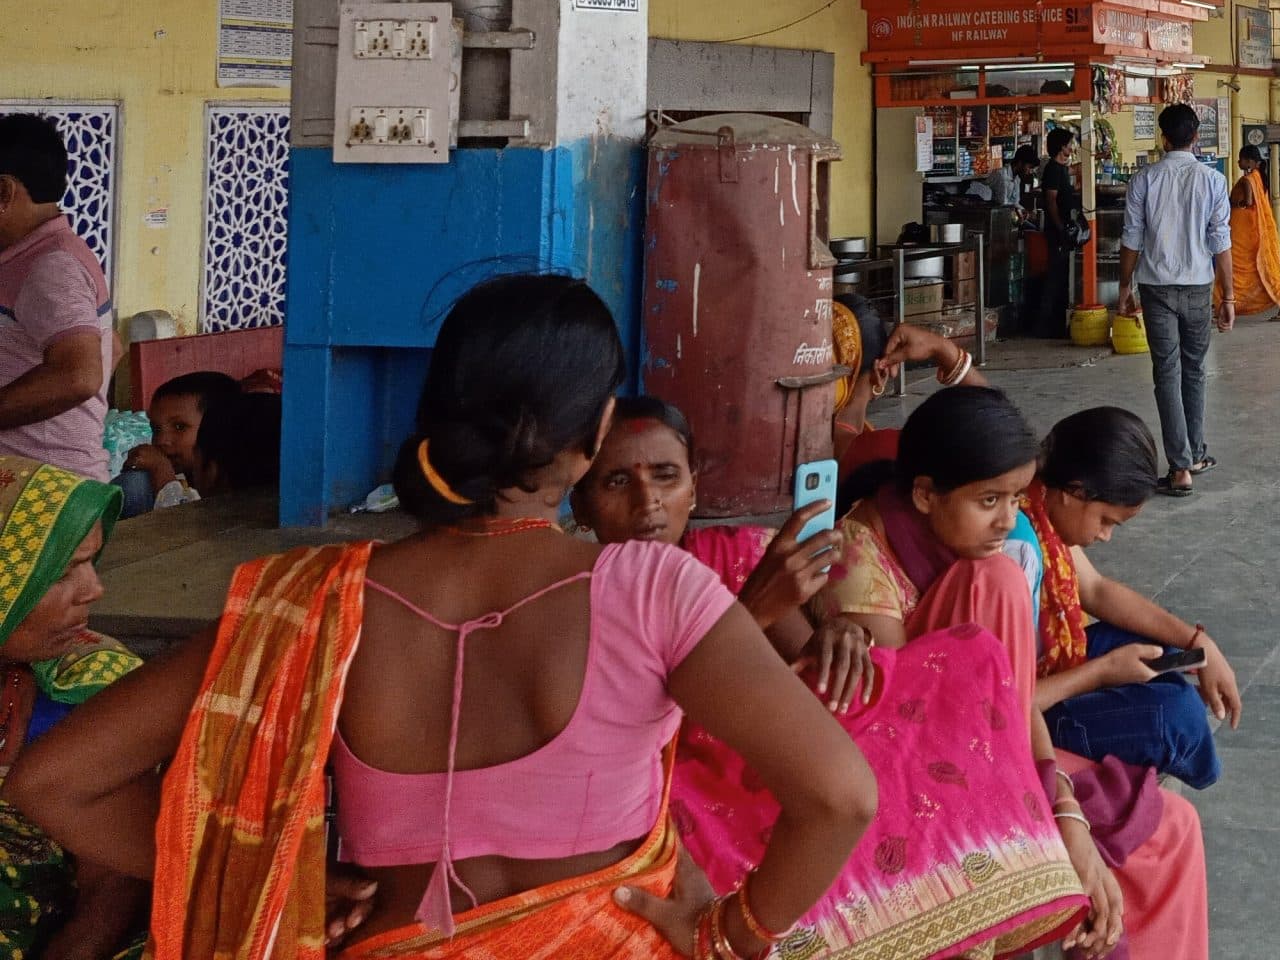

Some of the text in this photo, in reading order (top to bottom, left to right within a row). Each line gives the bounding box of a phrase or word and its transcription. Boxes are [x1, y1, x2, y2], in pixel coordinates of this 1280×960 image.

[932, 11, 972, 27] RAILWAY
[973, 9, 1020, 25] CATERING
[966, 29, 1008, 40] RAILWAY
